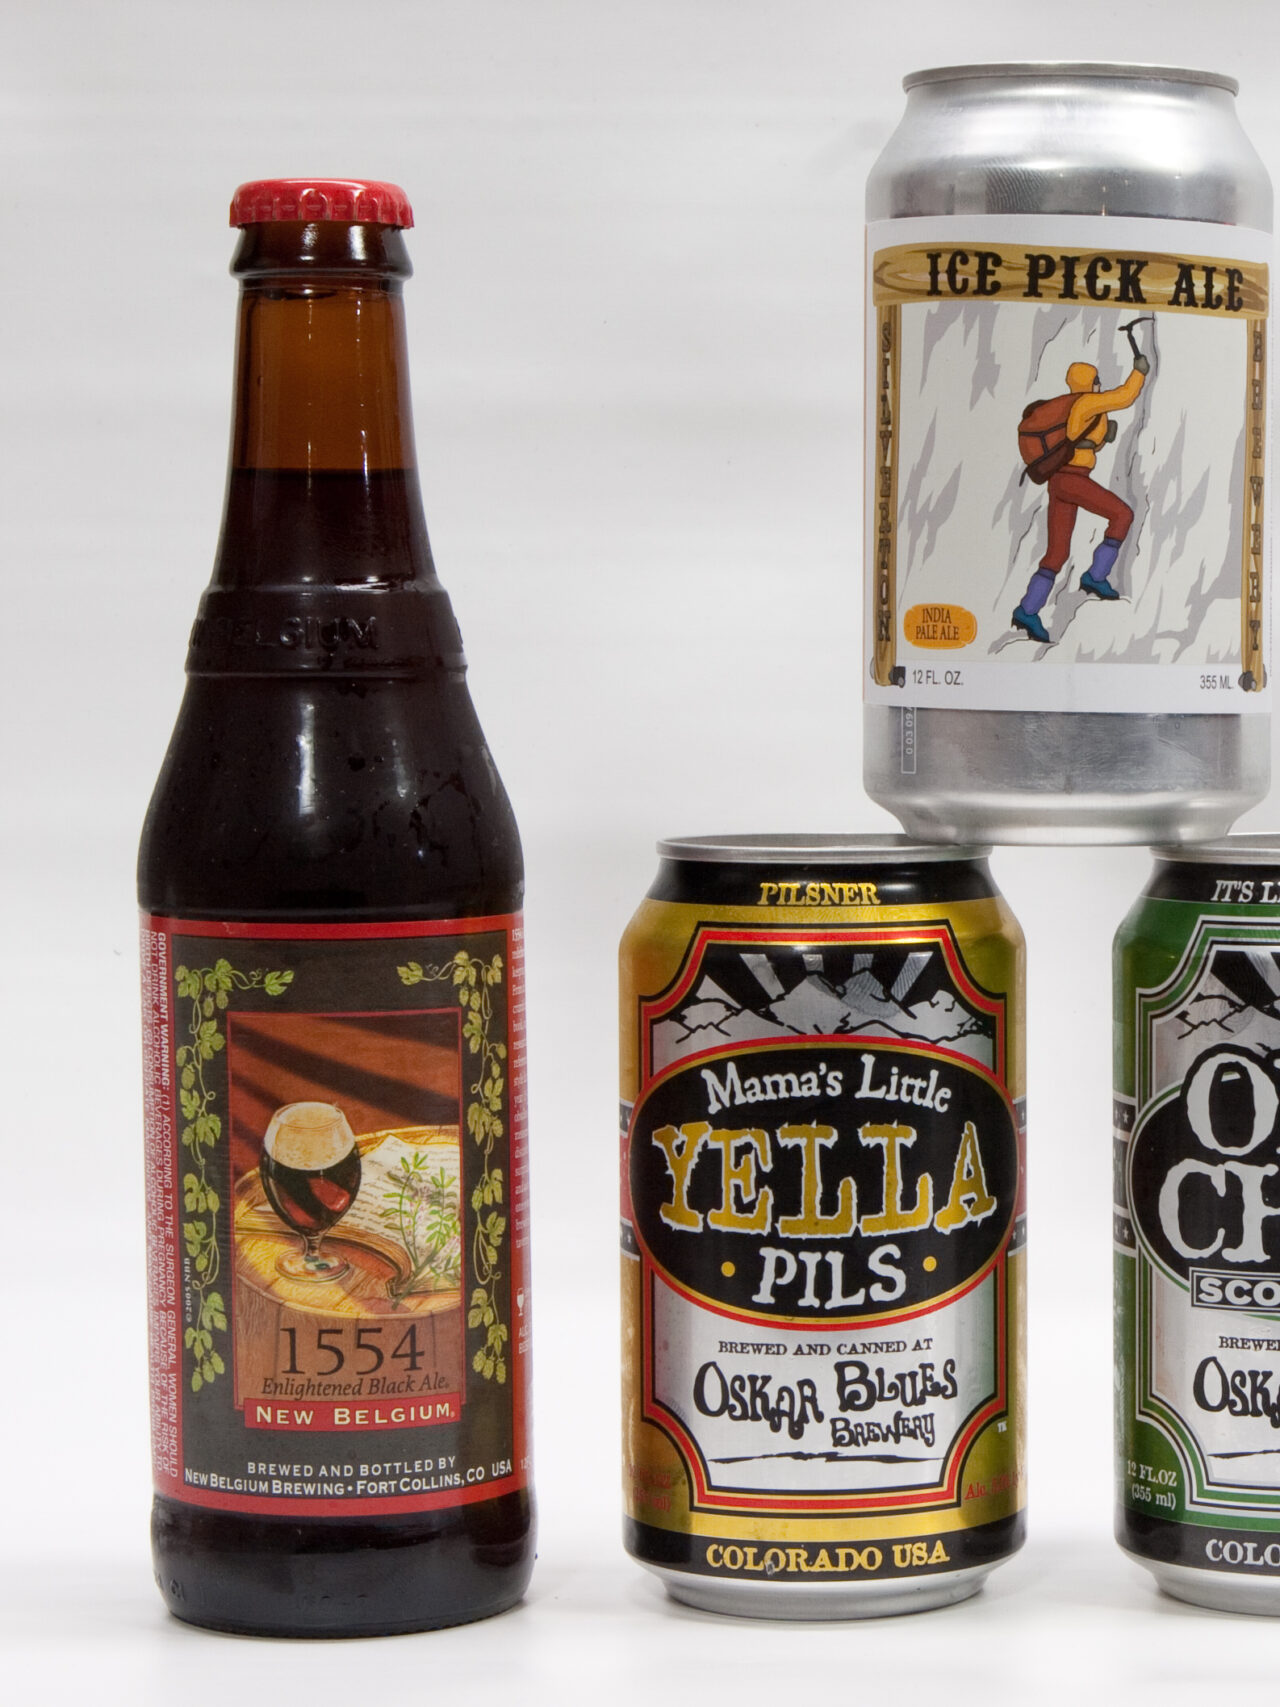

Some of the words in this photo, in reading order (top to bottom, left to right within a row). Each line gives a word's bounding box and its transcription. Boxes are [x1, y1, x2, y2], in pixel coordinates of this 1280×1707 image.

[927, 250, 1002, 296] ICE
[1023, 253, 1149, 304] PICK
[1167, 263, 1244, 312] ALE
[922, 607, 952, 624] INDIA
[915, 625, 938, 640] PALE
[939, 626, 960, 641] ALE
[912, 669, 923, 684] 12
[926, 670, 941, 685] FL.
[944, 670, 964, 686] OZ.
[1200, 675, 1215, 689] 355
[757, 882, 881, 906] PILSNER
[1210, 880, 1254, 903] IT'S
[158, 932, 168, 1021] GOVERNMENT
[160, 1024, 170, 1090] WARNING:
[701, 1061, 844, 1114] Mama's
[854, 1053, 952, 1112] Little
[162, 1114, 172, 1188] ACCORDING
[652, 1120, 998, 1239] YELLA
[164, 1194, 173, 1210] TO
[165, 1215, 174, 1238] THE
[166, 1243, 175, 1305] SURGEON
[751, 1243, 907, 1310] PILS
[279, 1323, 425, 1377] 1554
[718, 1340, 788, 1356] BREWED
[793, 1343, 832, 1356] AND
[836, 1340, 908, 1356] CANNED
[912, 1338, 933, 1351] AT
[168, 1373, 177, 1423] WOMEN
[261, 1376, 362, 1400] Enlightened
[367, 1373, 416, 1395] Black
[256, 1406, 313, 1425] NEW
[169, 1425, 178, 1477] SHOULD
[184, 1468, 209, 1486] NEW
[209, 1473, 269, 1494] BELGIUM
[271, 1477, 344, 1496] BREWING
[356, 1479, 397, 1495] FORT
[399, 1472, 465, 1492] COLLINS,
[466, 1467, 485, 1482] CO
[491, 1458, 512, 1477] USA
[247, 1461, 313, 1477] BREWED
[318, 1464, 355, 1477] AND
[359, 1461, 434, 1477] BOTTLED
[438, 1456, 455, 1471] BY
[1128, 1460, 1137, 1477] 12
[1132, 1483, 1152, 1502] (355
[1155, 1492, 1177, 1511] ml)
[706, 1545, 883, 1574] COLORADO
[893, 1540, 950, 1568] USA
